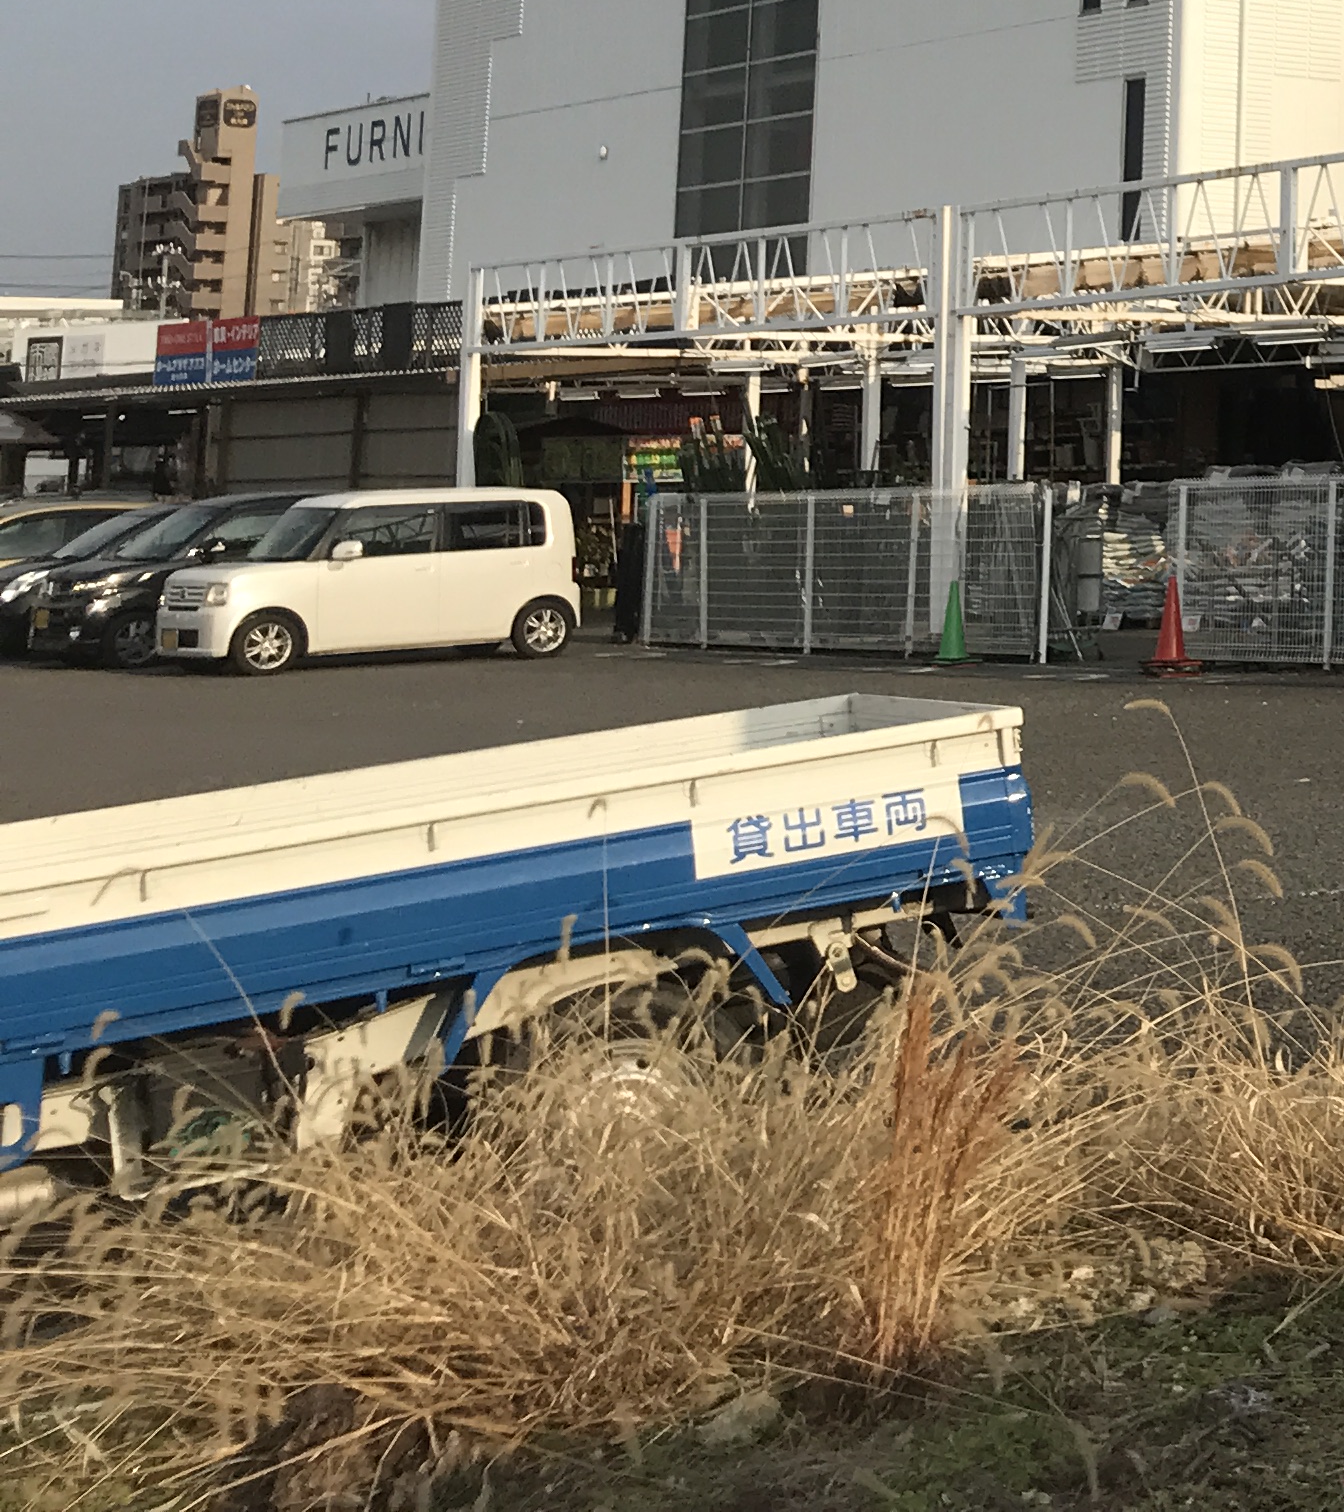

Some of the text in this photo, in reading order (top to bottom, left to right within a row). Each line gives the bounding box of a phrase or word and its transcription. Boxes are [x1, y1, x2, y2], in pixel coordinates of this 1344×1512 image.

[213, 356, 257, 375] ホームセンター
[727, 787, 927, 864] 貸出車両
